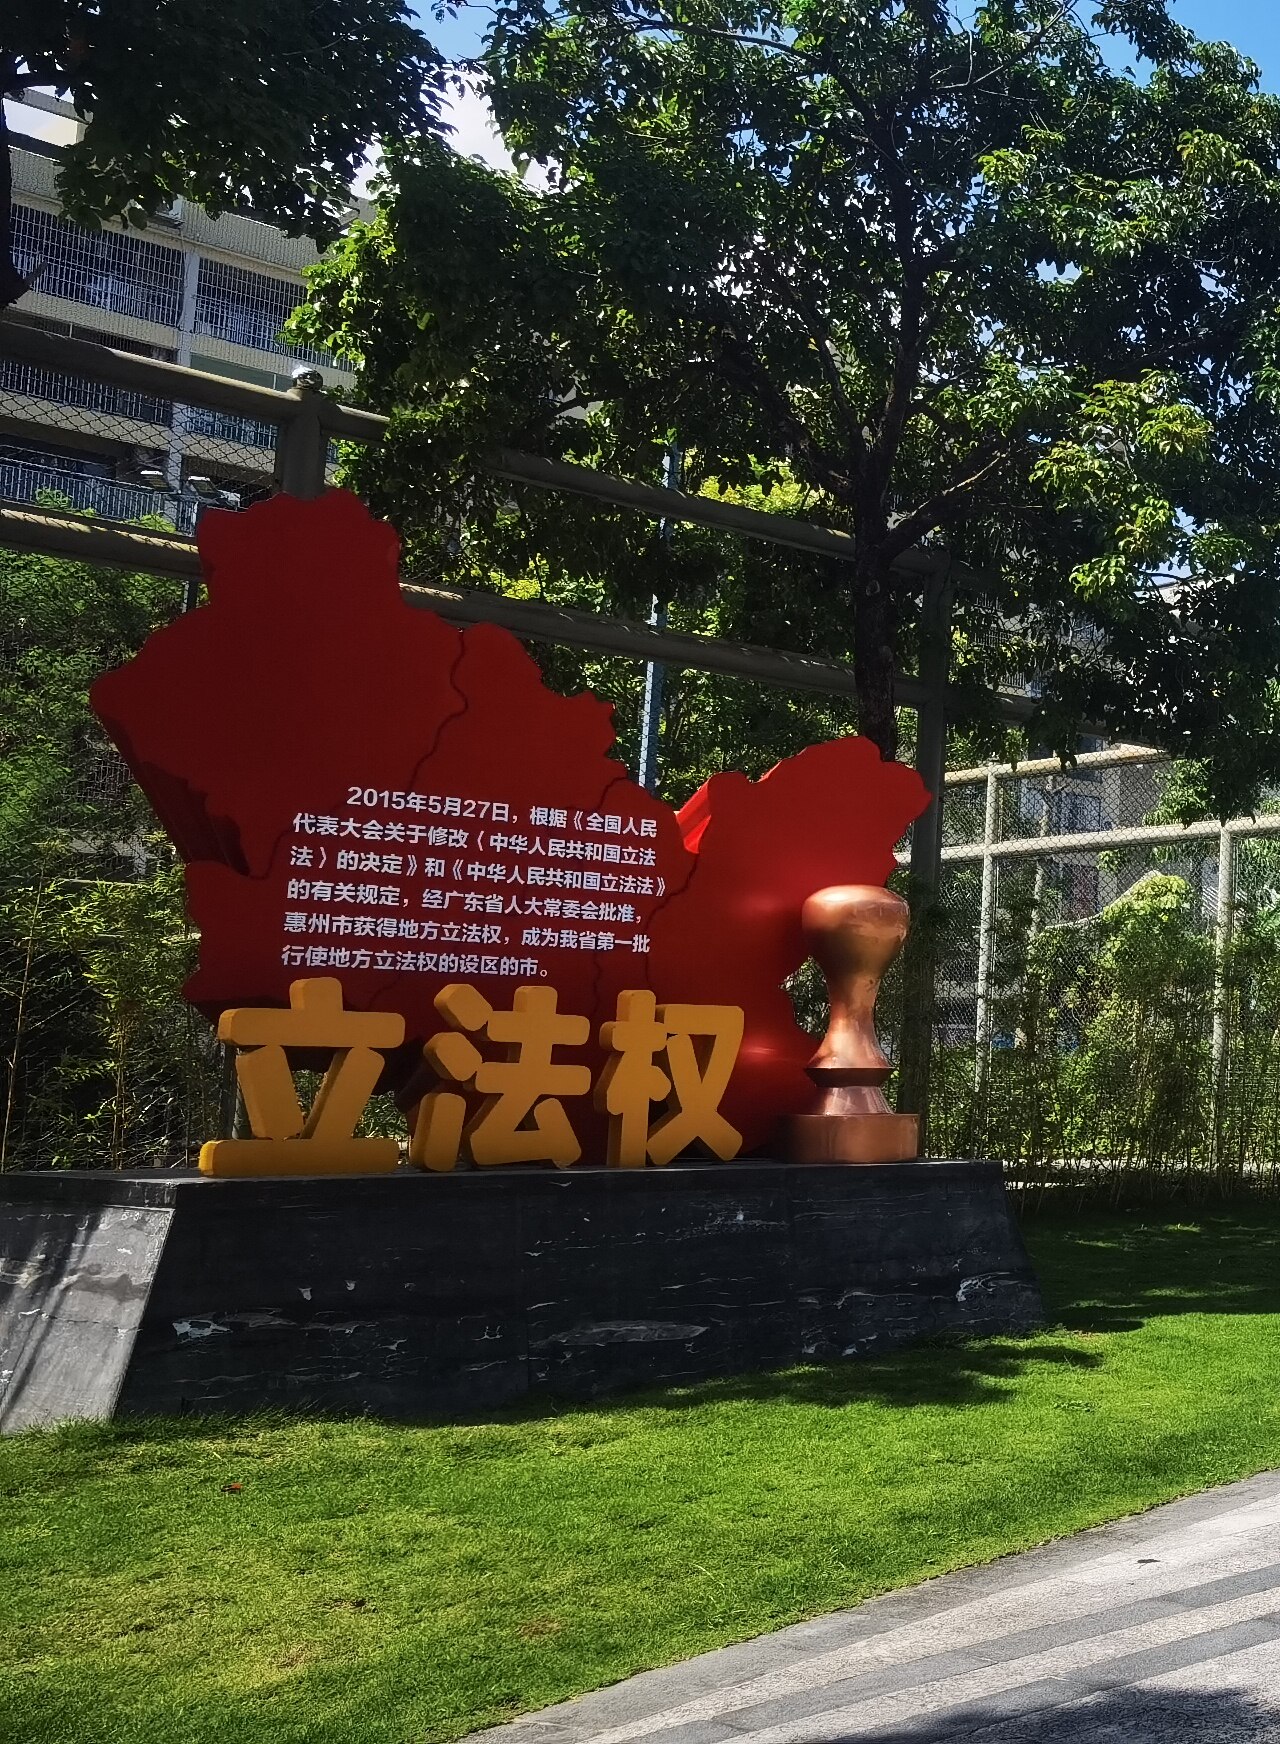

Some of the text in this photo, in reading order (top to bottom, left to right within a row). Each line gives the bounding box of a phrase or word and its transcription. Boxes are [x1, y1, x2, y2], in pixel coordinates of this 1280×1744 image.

[283, 910, 651, 954] 惠州市获得地方立法权，成为我省第一批
[280, 944, 549, 977] 行使地方立法权的设区的市。
[199, 977, 745, 1178] 立法权
